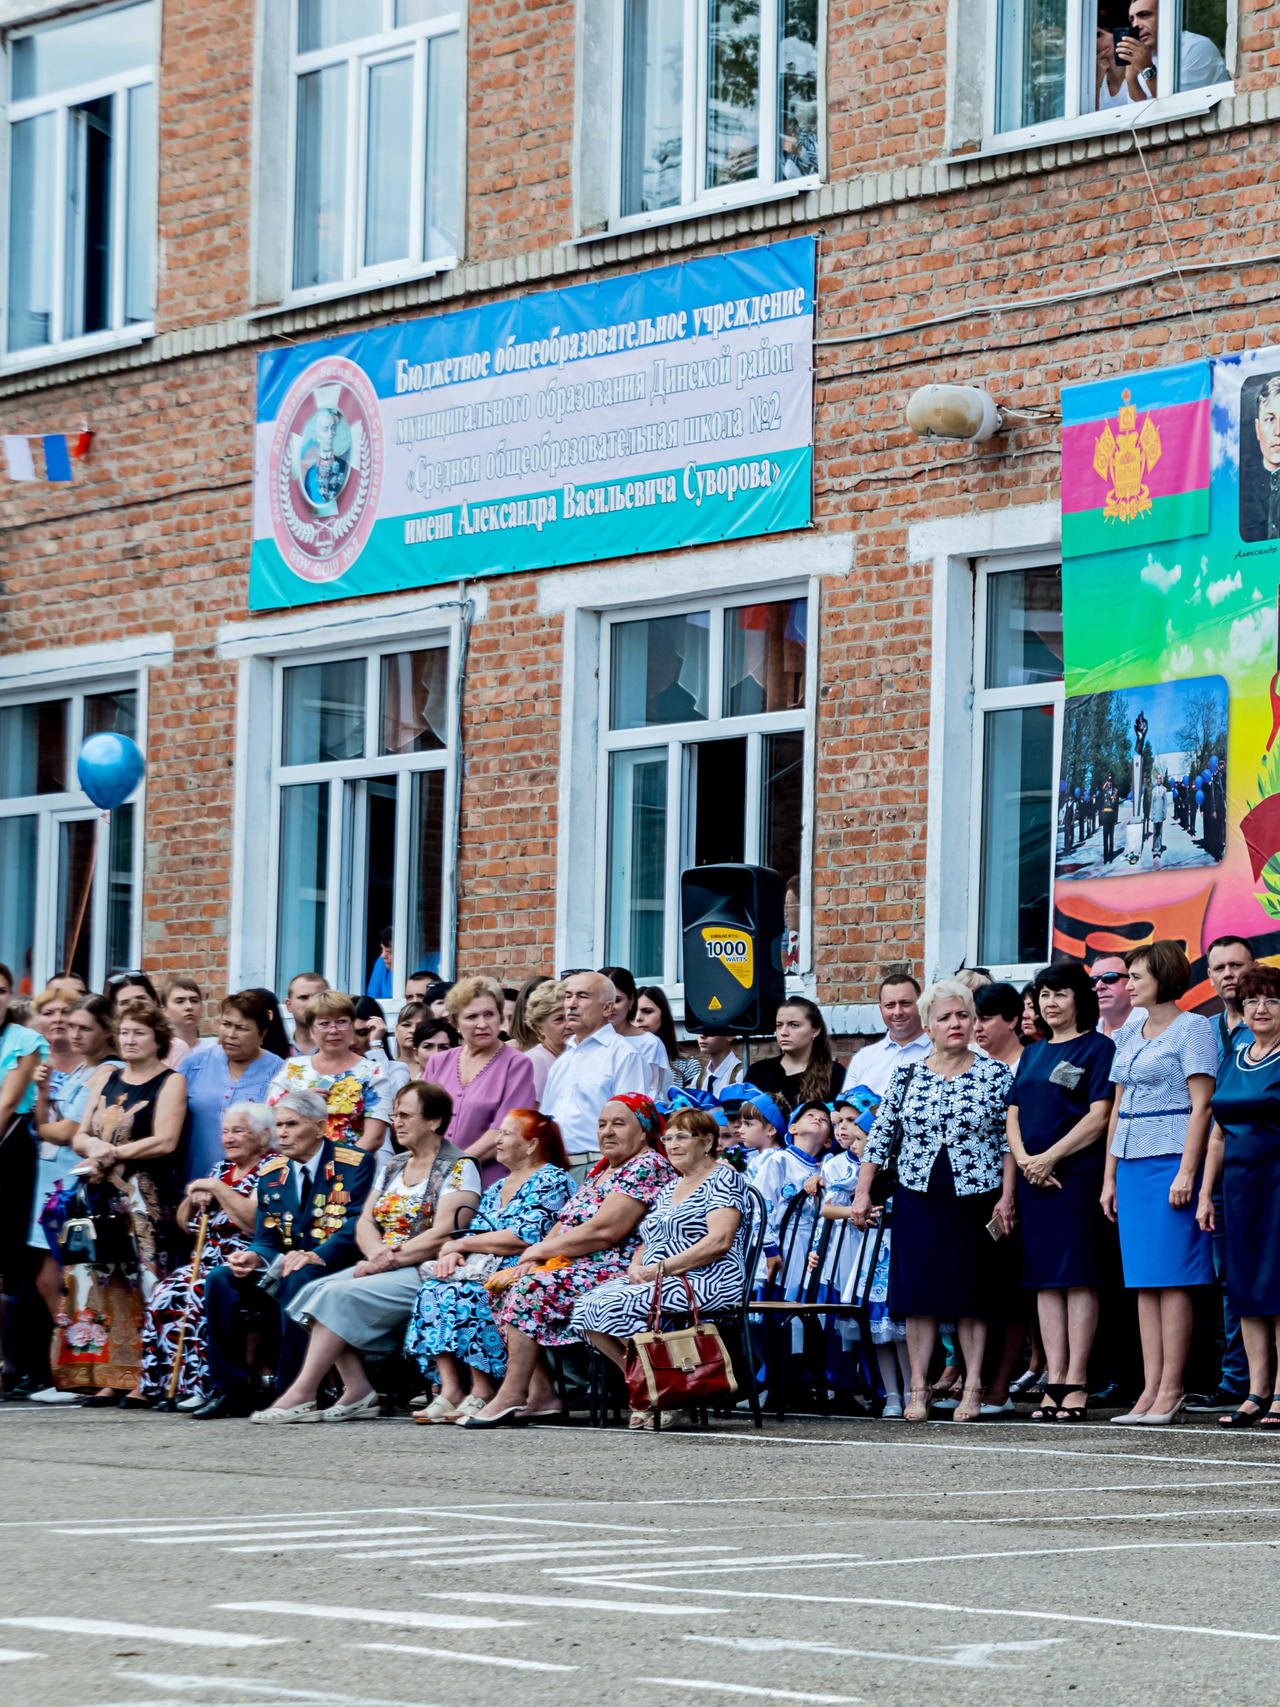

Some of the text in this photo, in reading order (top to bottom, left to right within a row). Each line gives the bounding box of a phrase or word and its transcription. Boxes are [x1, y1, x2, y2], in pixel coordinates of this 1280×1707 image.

[395, 286, 805, 395] Бюджетное общеобразовательное учреждение
[395, 336, 794, 451] муниципального образования Динской район
[405, 390, 782, 499] «Средняя общеобразовательная школа №2
[404, 458, 782, 546] имени Александра Васильевича Суворова»
[1233, 547, 1278, 561] Александр
[706, 940, 748, 958] 1000
